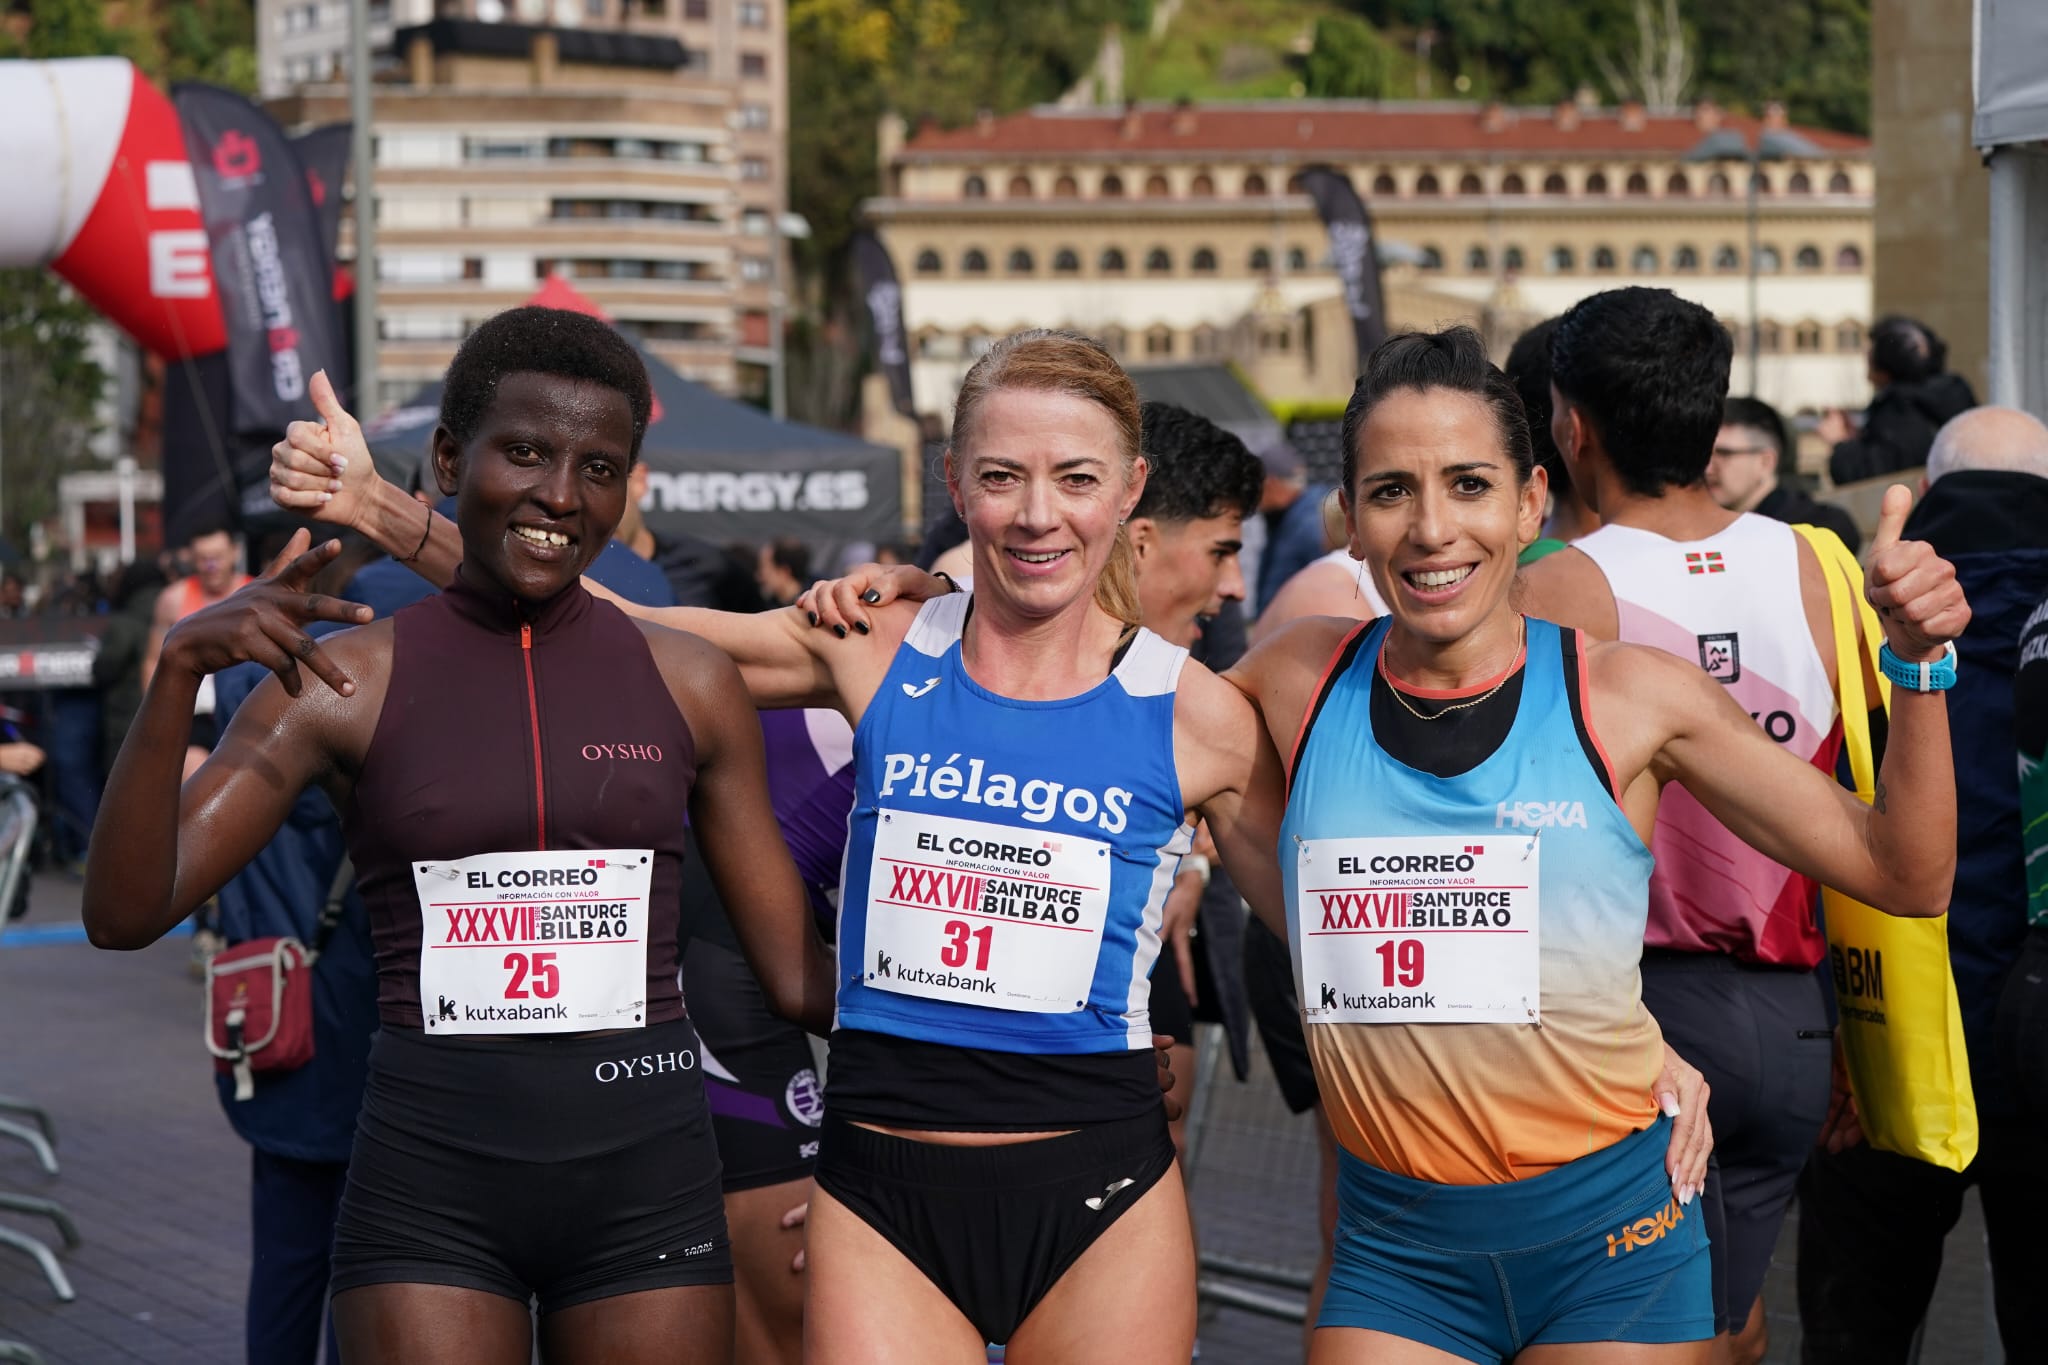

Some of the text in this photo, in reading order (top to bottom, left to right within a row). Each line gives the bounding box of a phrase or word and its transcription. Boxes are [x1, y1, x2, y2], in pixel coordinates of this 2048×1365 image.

[582, 743, 663, 762] OYSHO
[1495, 800, 1588, 829] HOKA
[916, 832, 1052, 867] EL CORREO
[945, 858, 1050, 880] INFORMACIÓN CON VALOR
[1338, 854, 1475, 874] EL CORREO
[467, 868, 598, 888] EL CORREO
[1369, 877, 1426, 886] INFORMACIÓN
[1447, 877, 1475, 885] VALOR
[497, 890, 599, 900] INFORMACIÓN CON VALOR
[985, 879, 1082, 906] SANTURCE
[1412, 891, 1511, 907] SANTURCE
[540, 903, 627, 920] SANTURCE
[940, 919, 994, 971] 31
[1375, 938, 1425, 988] 19
[1847, 946, 1883, 1001] BM
[503, 952, 560, 999] 25
[897, 963, 997, 994] kutxabank
[465, 1003, 568, 1021] kutxabank
[1343, 991, 1436, 1009] kutxabank
[595, 1049, 695, 1083] OYSHO
[1606, 1198, 1684, 1258] HOKA
